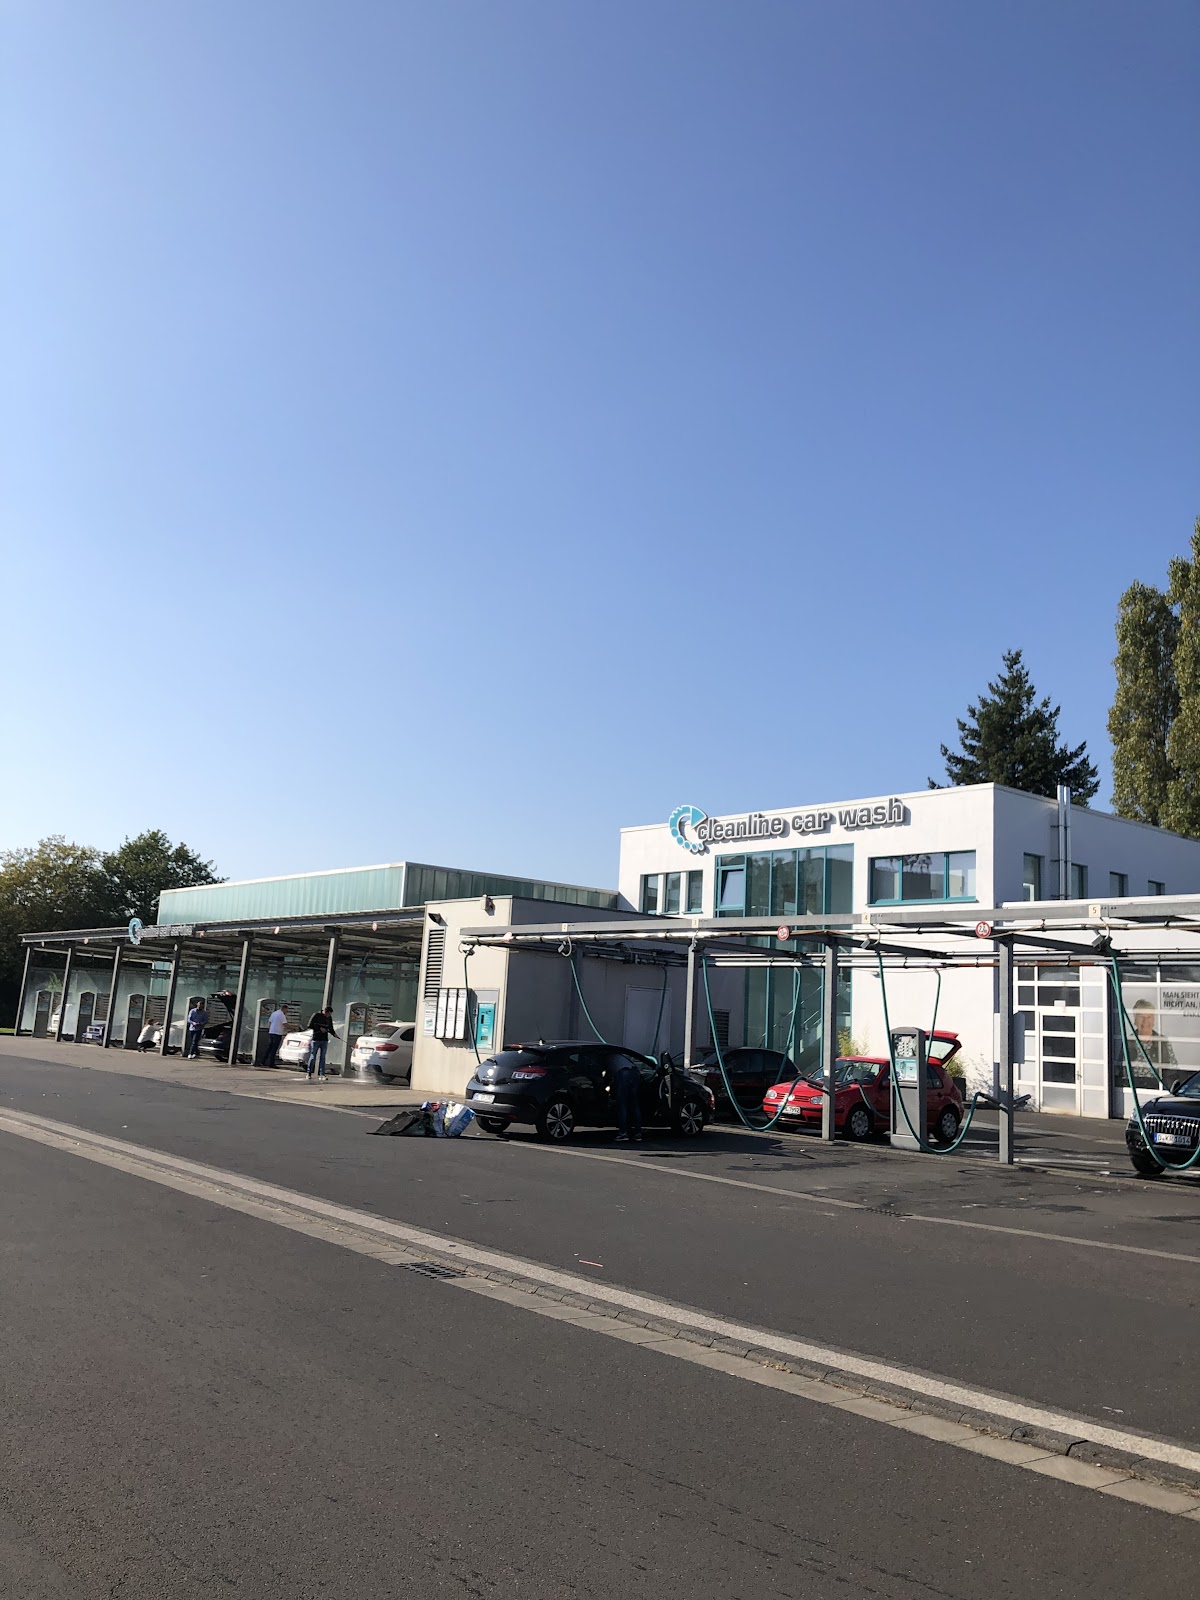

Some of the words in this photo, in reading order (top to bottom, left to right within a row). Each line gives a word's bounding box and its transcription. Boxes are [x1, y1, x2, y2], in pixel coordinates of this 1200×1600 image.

[697, 813, 784, 841] cleanline
[791, 811, 830, 833] car
[838, 797, 904, 827] wash
[1162, 991, 1179, 999] MAN
[1180, 991, 1200, 999] SIEHT
[1163, 1000, 1184, 1008] NICHT
